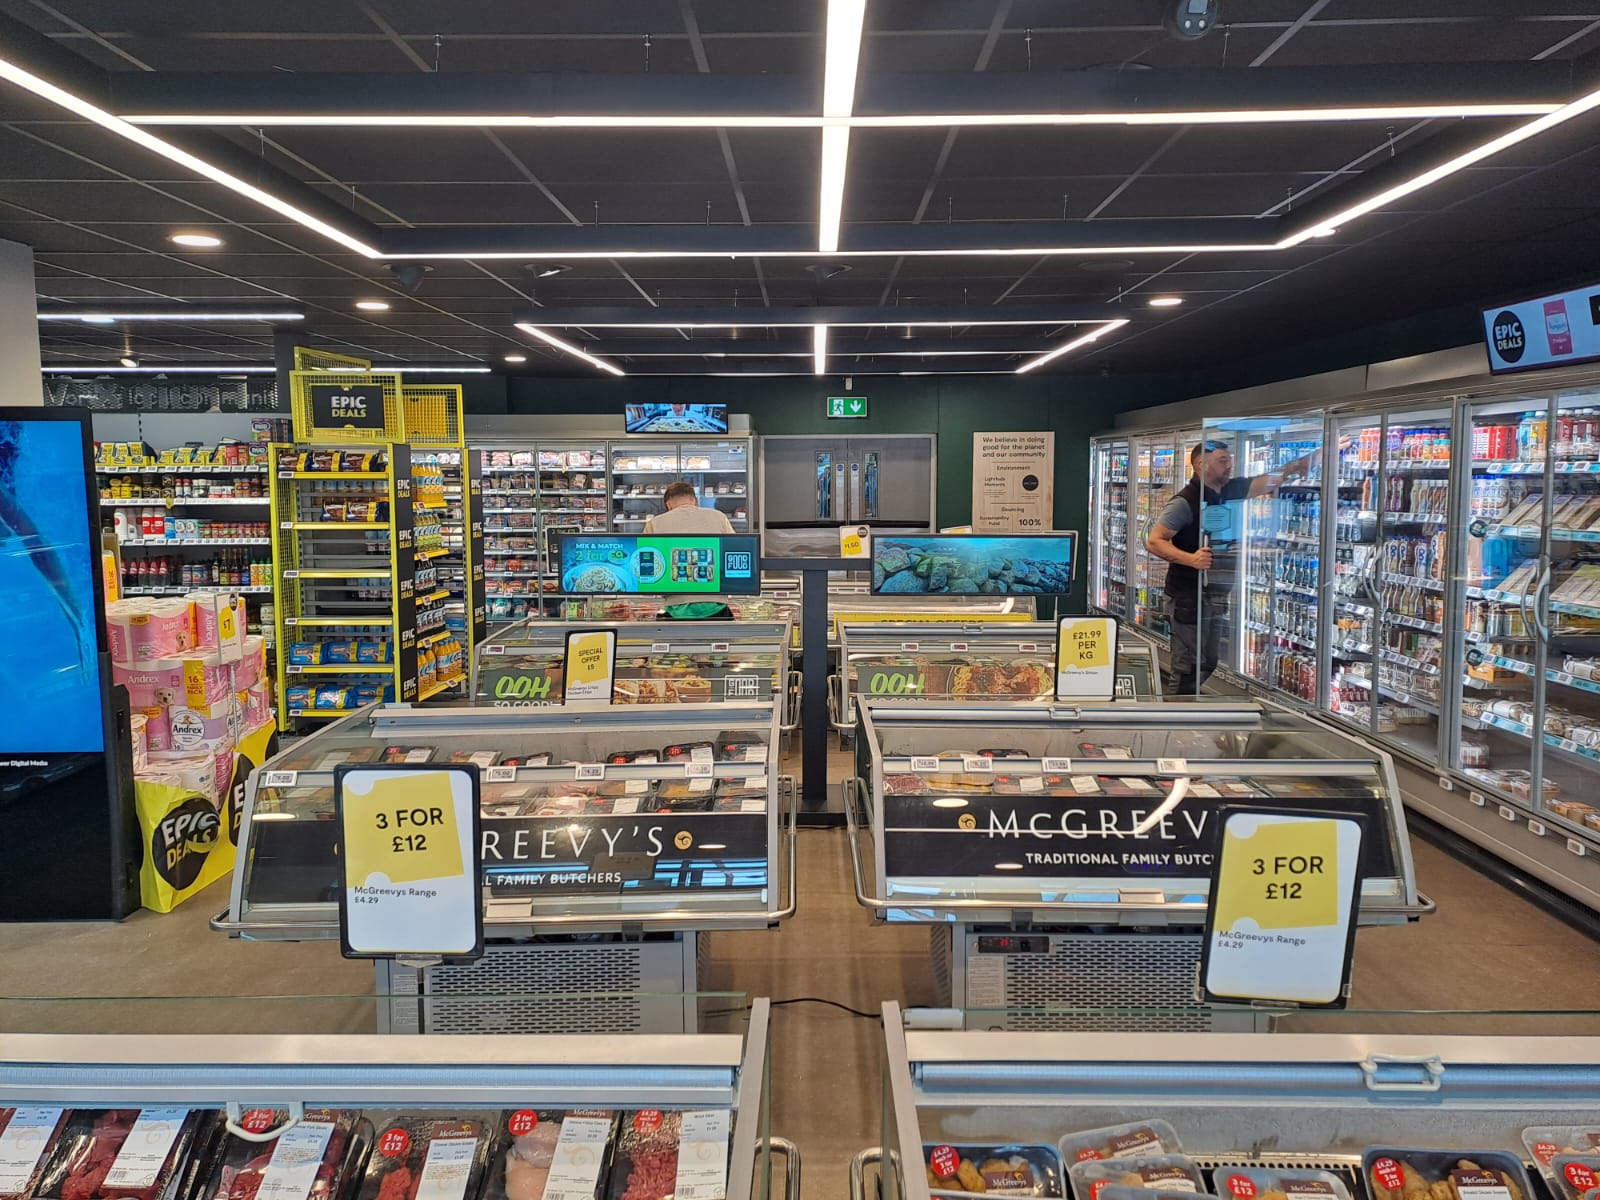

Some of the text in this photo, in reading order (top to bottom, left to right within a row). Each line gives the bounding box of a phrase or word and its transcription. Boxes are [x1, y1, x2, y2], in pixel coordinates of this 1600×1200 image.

[1495, 322, 1522, 340] EPIC
[1497, 337, 1523, 351] DEALS
[331, 396, 367, 408] EPIC
[332, 409, 367, 418] DEALS
[398, 480, 410, 489] EPIC
[1019, 519, 1042, 527] 100%
[399, 530, 411, 541] EPIC
[576, 551, 583, 561] 2
[586, 550, 604, 561] for
[401, 580, 414, 591] EPIC
[223, 618, 231, 631] £7
[402, 628, 415, 641] EPIC
[1073, 630, 1102, 640] £21.99
[1078, 641, 1096, 650] PER
[578, 648, 603, 657] SPECIAL
[1079, 651, 1093, 660] KG
[581, 655, 601, 664] OFFER
[128, 675, 159, 684] Andrex
[188, 675, 199, 683] 16
[404, 677, 416, 691] EPIC
[495, 676, 552, 699] OOH
[871, 673, 926, 696] OOH
[173, 723, 204, 735] Andrex
[11, 760, 29, 768] Digital
[375, 807, 444, 830] 3 FOR
[162, 812, 219, 848] EPIC
[392, 834, 427, 853] £12
[1026, 853, 1119, 866] TRADITIONAL
[1122, 854, 1170, 867] FAMILY
[1252, 856, 1324, 875] 3 FOR
[497, 873, 545, 886] FAMILY
[550, 872, 622, 885] BUTCHERS
[354, 886, 437, 899] McGreevys Range
[1266, 882, 1303, 900] £12
[354, 897, 379, 905] £4.29
[1219, 931, 1306, 947] McGreevys Range
[1218, 940, 1244, 950] £4.29
[251, 1110, 269, 1119] 3 for
[515, 1114, 533, 1122] 3 for
[247, 1121, 267, 1129] £12
[514, 1122, 531, 1131] £12
[386, 1133, 393, 1141] 3
[439, 1129, 473, 1139] McGreevys
[384, 1142, 402, 1151] £12
[1116, 1135, 1151, 1149] McGreevys
[934, 1146, 950, 1158] £4.29
[1376, 1160, 1393, 1168] £4.29
[943, 1167, 955, 1176] £12
[1569, 1167, 1590, 1177] 3 for
[992, 1178, 1027, 1188] McGreevys
[1388, 1179, 1401, 1188] £12
[1461, 1176, 1499, 1186] McGreevys
[1574, 1176, 1594, 1187] £12
[1234, 1187, 1253, 1195] £12
[1291, 1185, 1328, 1194] McGreevys
